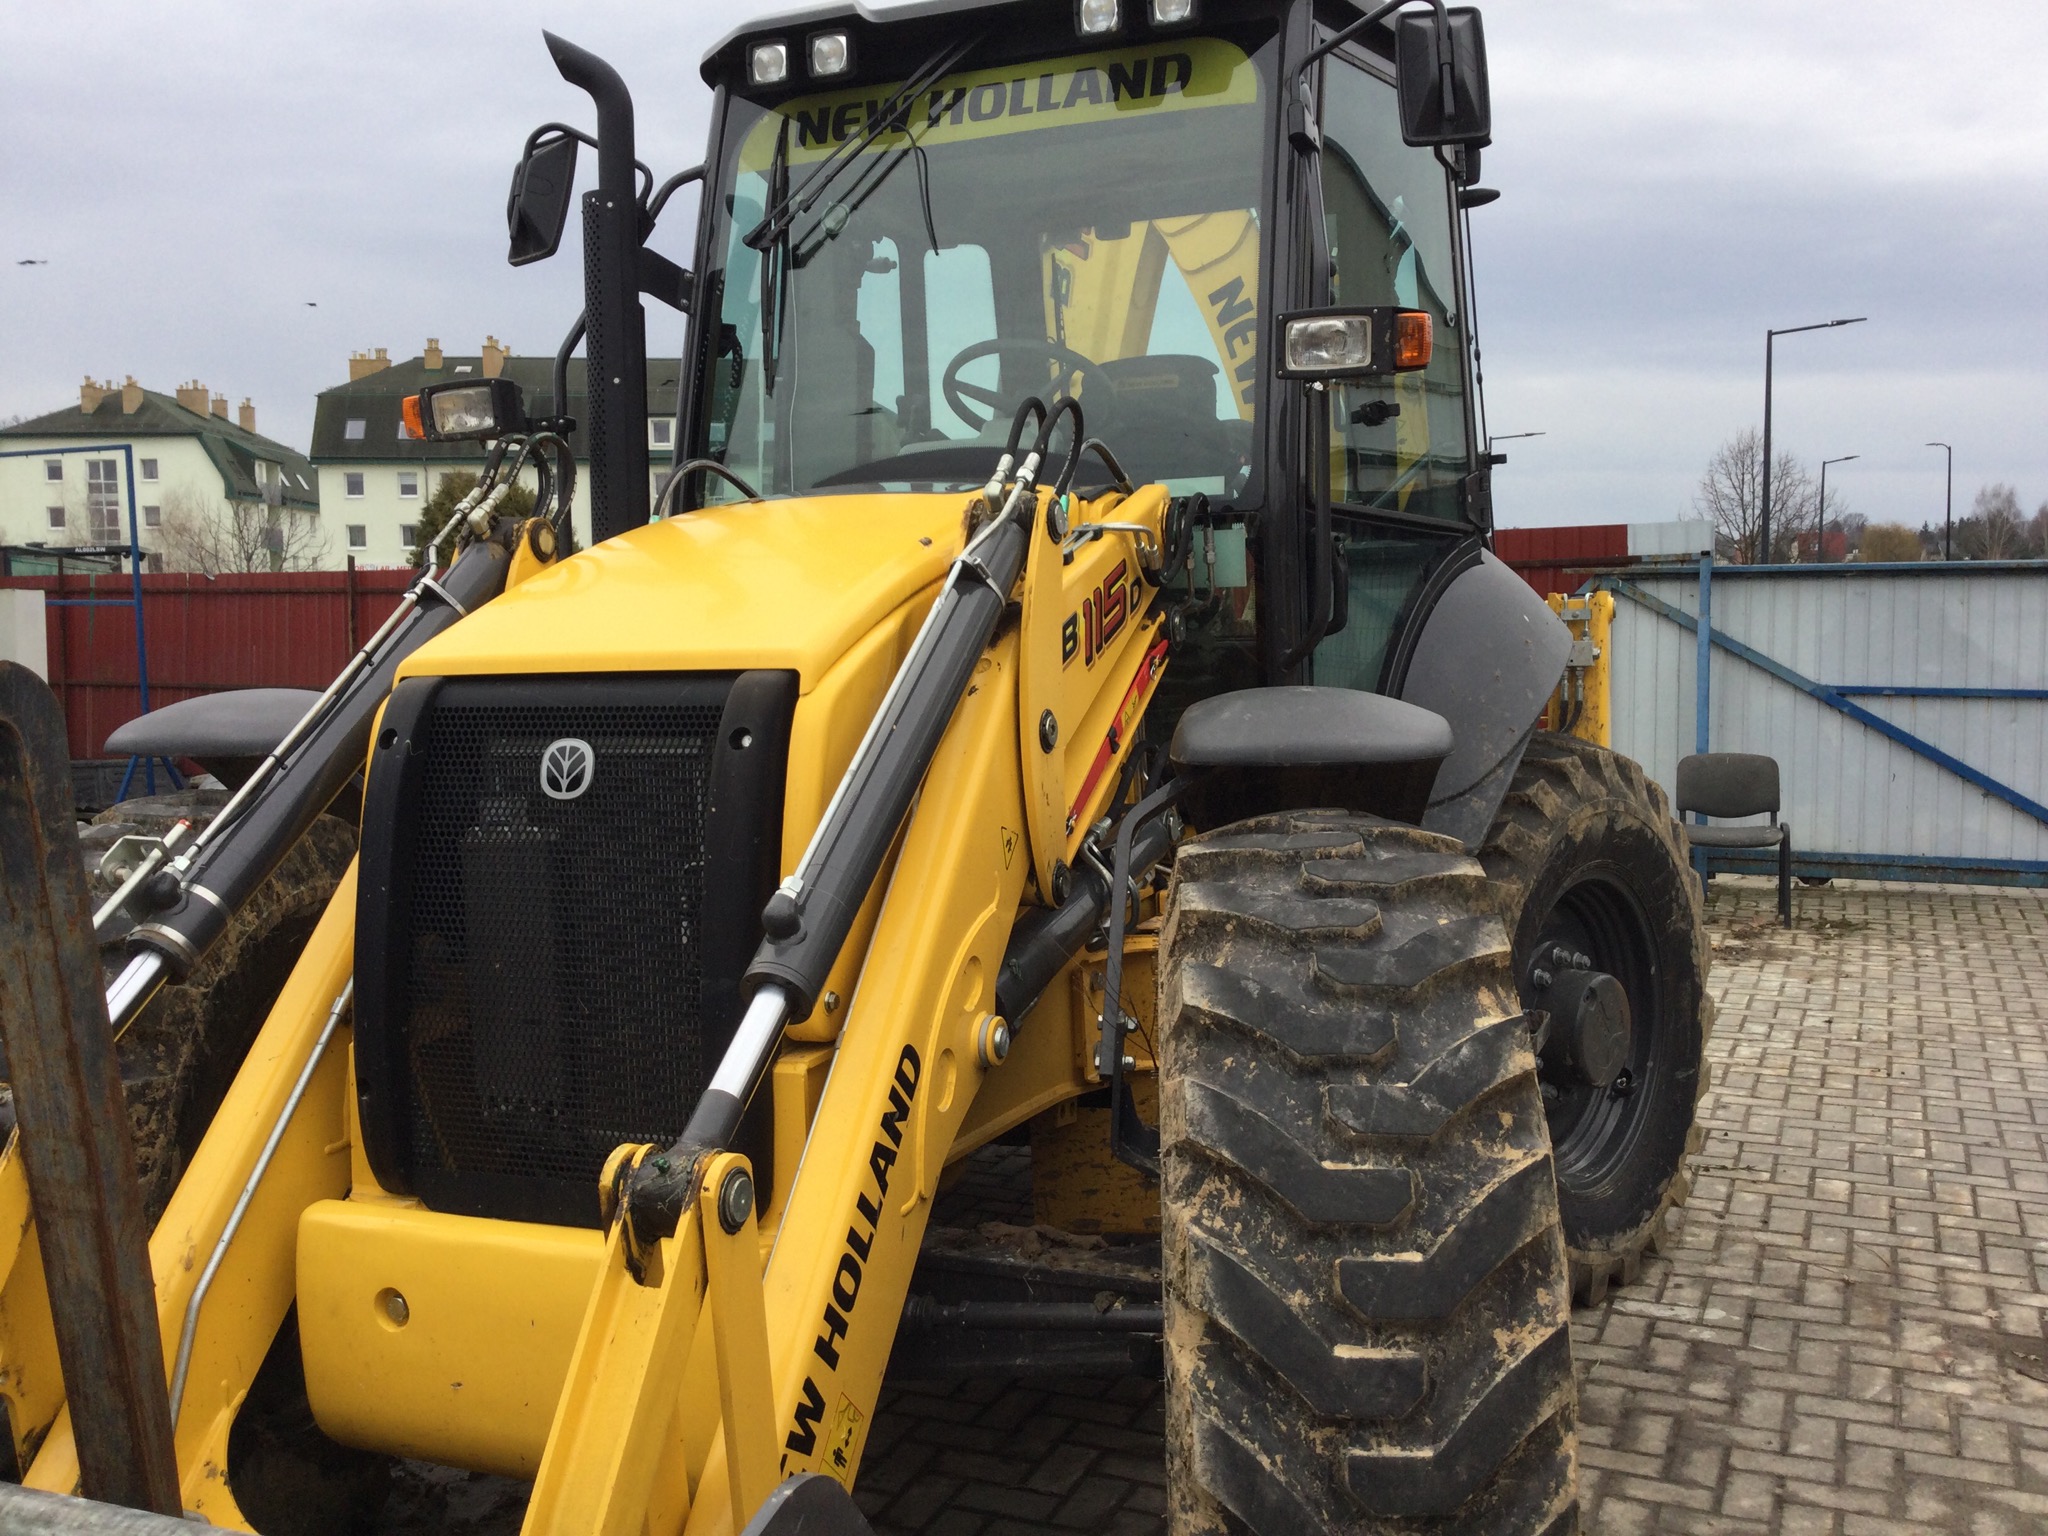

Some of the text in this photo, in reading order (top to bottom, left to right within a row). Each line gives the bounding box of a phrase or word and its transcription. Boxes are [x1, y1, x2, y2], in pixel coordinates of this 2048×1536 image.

[795, 52, 1193, 148] NEW HOLLAND
[813, 1043, 921, 1373] HOLLAND
